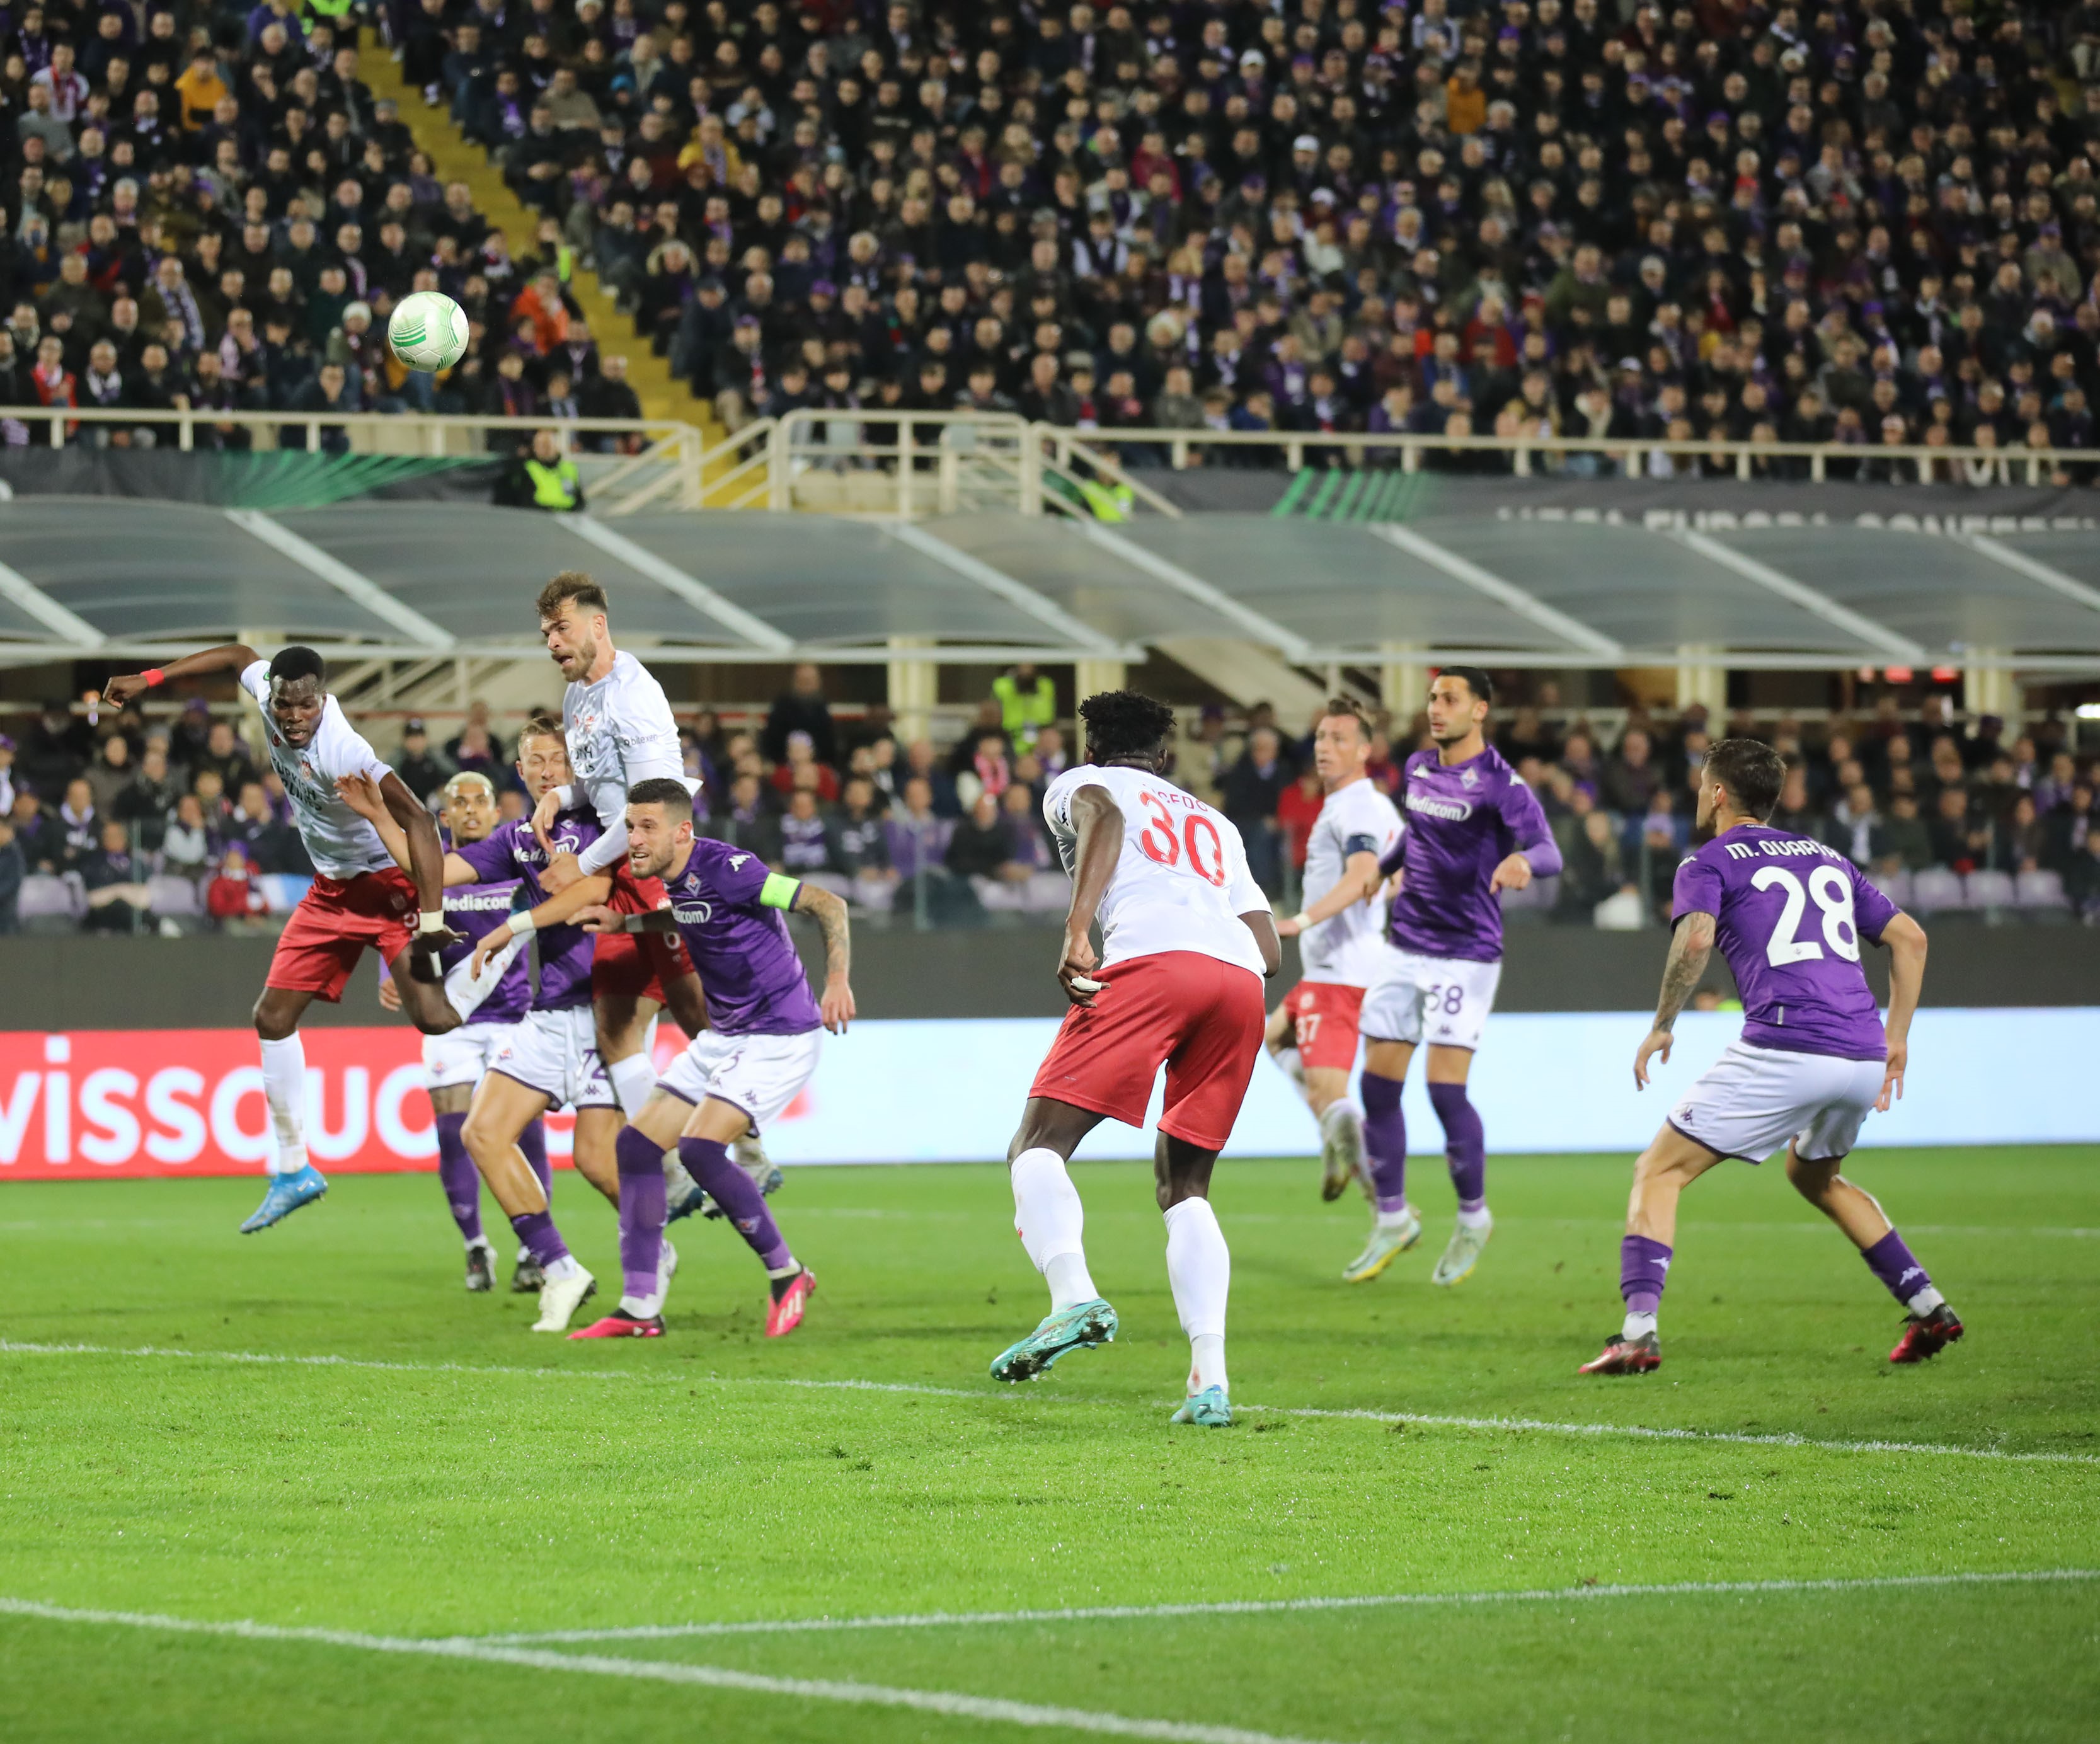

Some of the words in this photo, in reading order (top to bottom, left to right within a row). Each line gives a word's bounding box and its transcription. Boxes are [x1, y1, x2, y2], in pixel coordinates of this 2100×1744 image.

[1139, 790, 1225, 888] 30
[1758, 839, 1843, 863] QUARTA
[1750, 864, 1861, 968] 28
